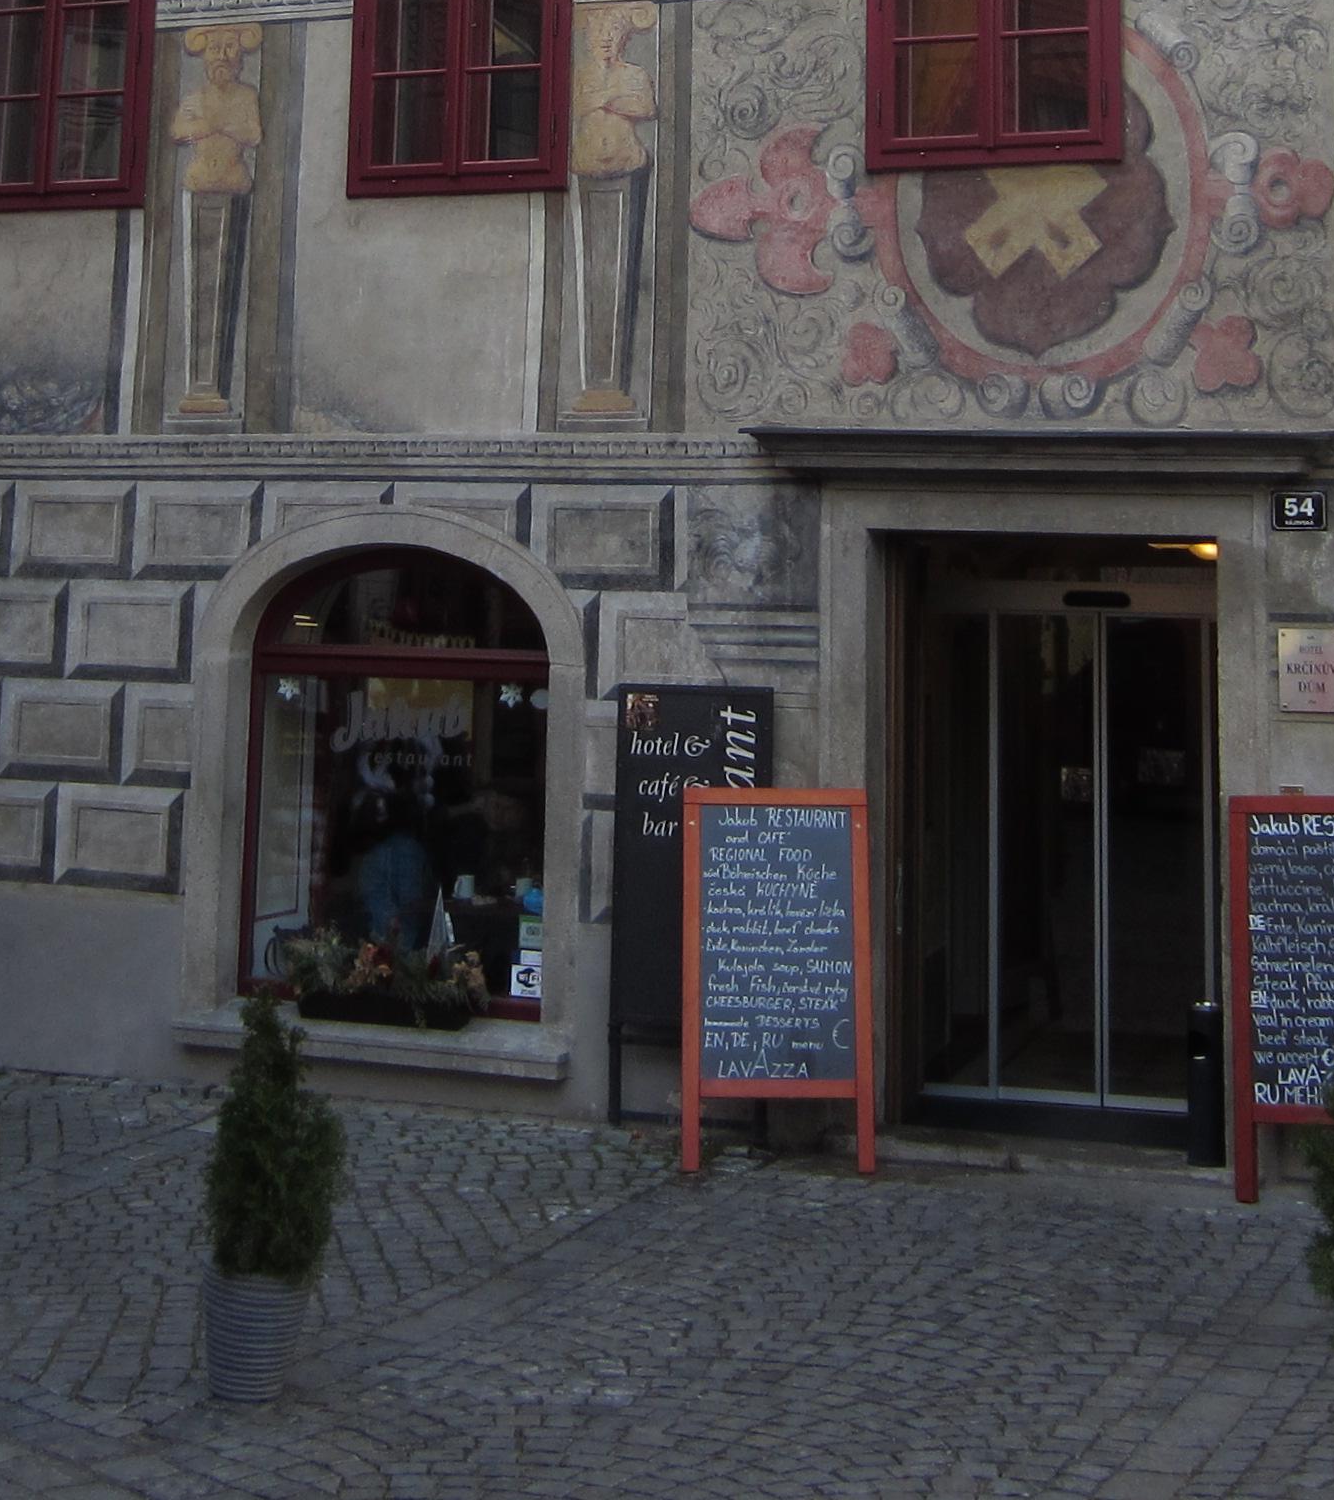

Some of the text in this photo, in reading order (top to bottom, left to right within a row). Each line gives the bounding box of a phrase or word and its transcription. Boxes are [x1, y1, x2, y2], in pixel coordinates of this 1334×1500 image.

[1284, 498, 1315, 517] 54
[1299, 644, 1324, 654] HOTEL
[330, 690, 465, 753] Jakub
[630, 731, 712, 757] hotel &
[638, 772, 681, 803] café
[642, 811, 679, 837] bar
[718, 807, 847, 829] Jakub RESTAURANT
[1249, 814, 1300, 836] Jakub
[725, 830, 749, 844] and
[709, 847, 812, 862] REGIONAL FOOD
[1248, 914, 1266, 930] DE
[806, 958, 852, 974] SALMON
[707, 974, 739, 993] fresh
[797, 997, 839, 1011] STEAK
[1250, 990, 1268, 1008] EN
[754, 1015, 820, 1029] DESSERTS
[1280, 1012, 1293, 1025] in
[762, 1031, 783, 1049] RU
[791, 1040, 825, 1050] menu
[1257, 1028, 1288, 1046] beef
[717, 1048, 809, 1078] LAVAZZA
[1253, 1051, 1273, 1064] we
[1276, 1047, 1321, 1067] accept
[1253, 1082, 1280, 1105] RU
